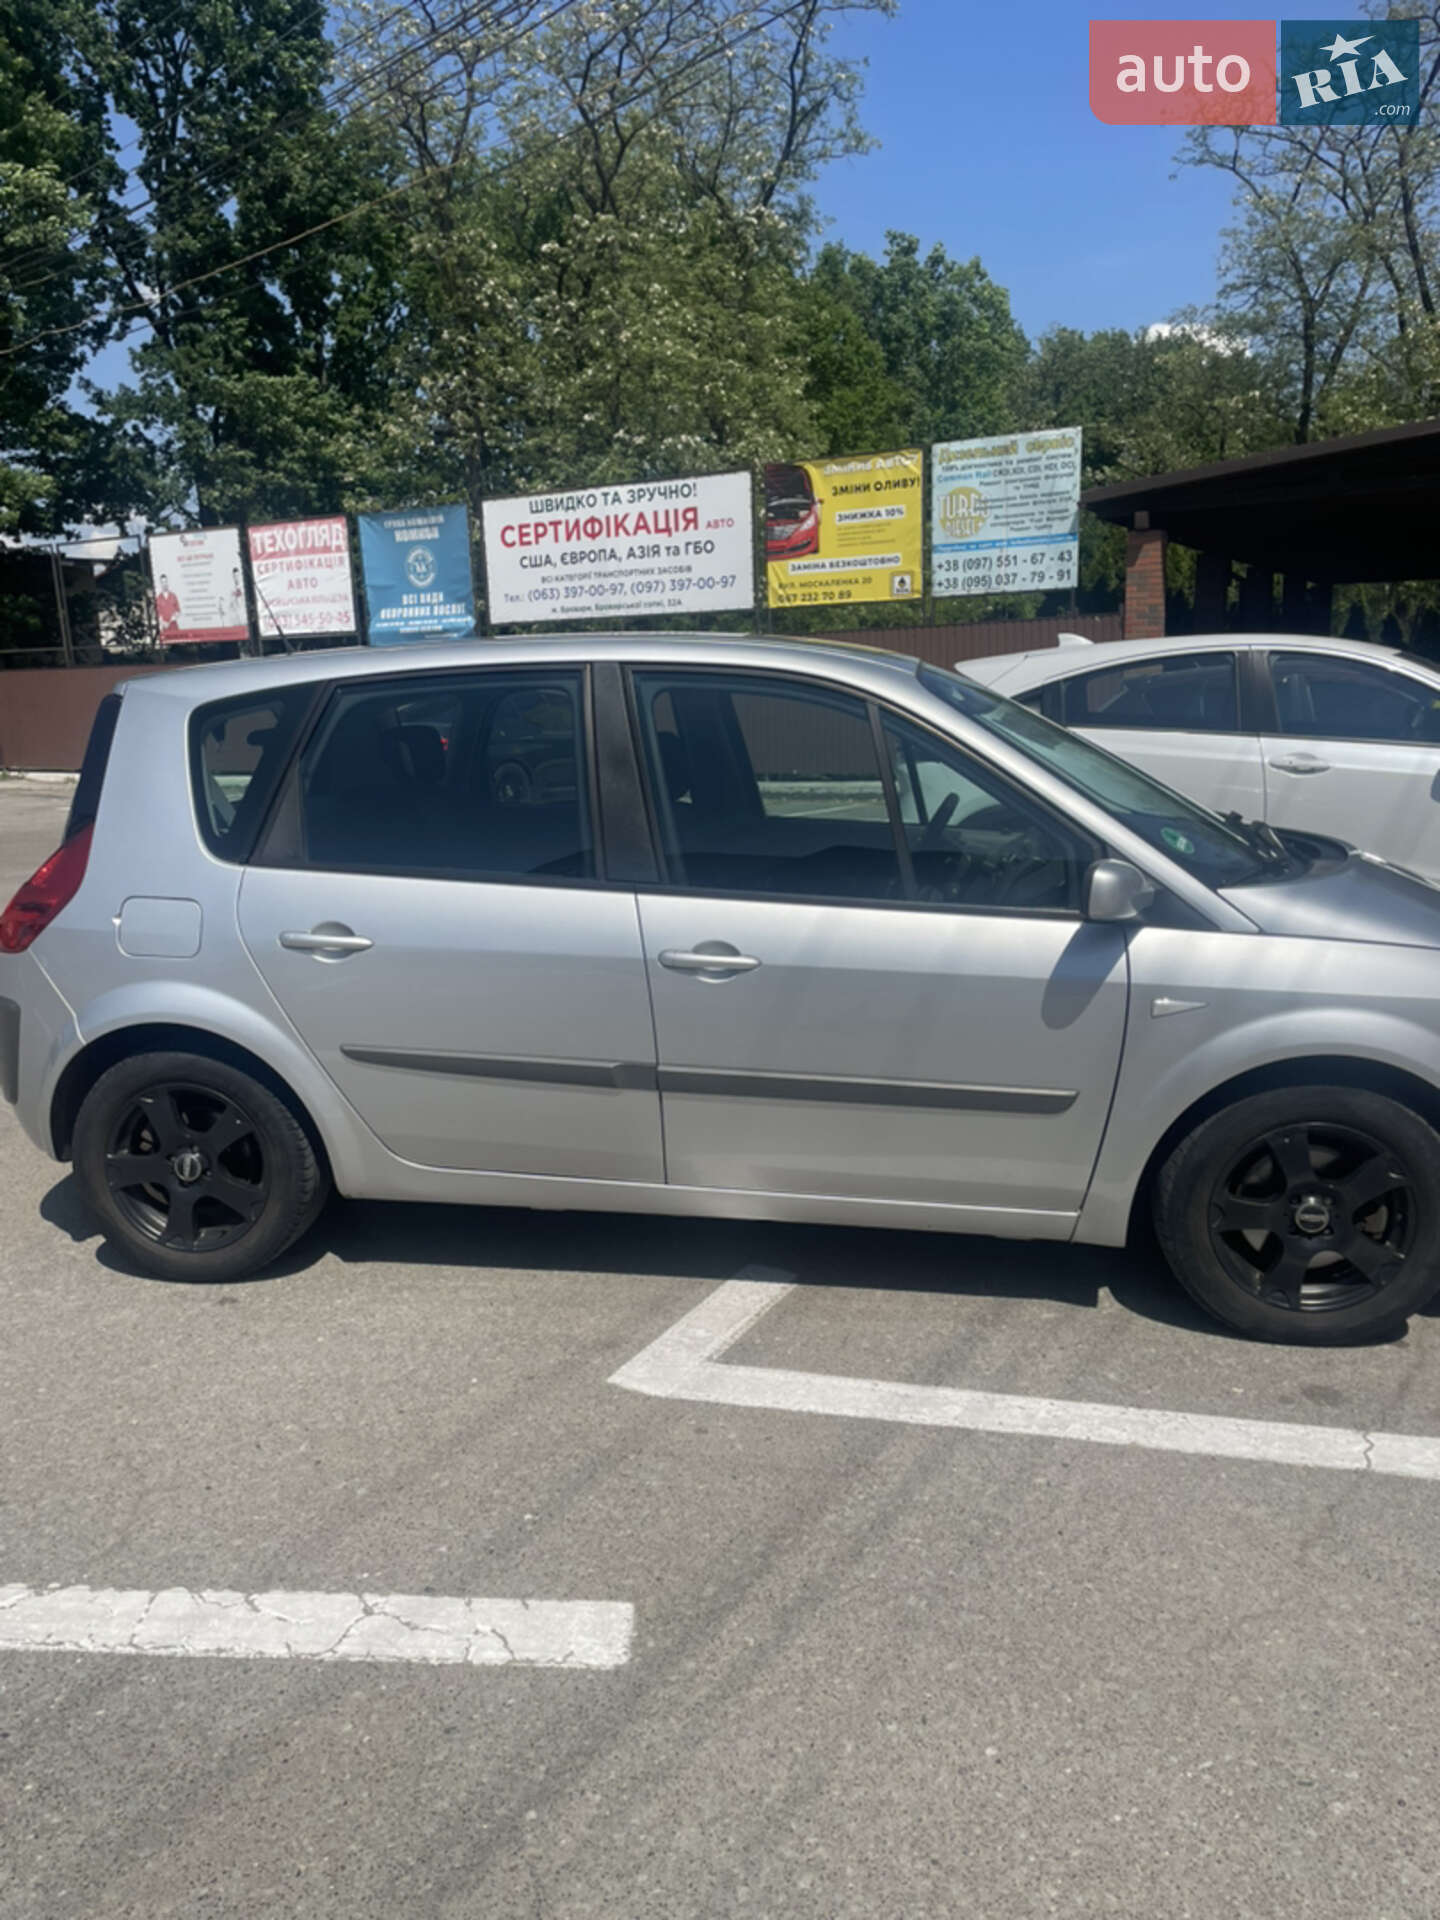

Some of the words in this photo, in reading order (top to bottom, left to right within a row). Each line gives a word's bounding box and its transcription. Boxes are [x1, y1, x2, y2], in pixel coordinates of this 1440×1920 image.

[832, 483, 871, 496] ЗМІНИ
[873, 476, 920, 492] ОЛИВУ!
[528, 493, 598, 514] ШВИДКО
[601, 491, 623, 506] ТА
[626, 482, 698, 504] ЗРУЧНО!
[500, 506, 699, 548] СЕРТИФІКАЦІЯ
[705, 517, 735, 529] АВТО
[838, 509, 882, 522] ЗНИЖКА
[252, 523, 346, 555] ТЕХОГЛЯД
[519, 553, 558, 569] США,
[560, 547, 623, 566] ЄВРОПА,
[626, 543, 662, 560] АЗІЯ
[665, 544, 681, 557] та
[684, 539, 716, 557] ГБО
[790, 561, 827, 572] ЗАМІНА
[829, 554, 901, 569] БЕЗКОШТОВНО
[937, 559, 960, 572] +38
[963, 556, 993, 573] (097)
[996, 554, 1018, 568] 551
[1030, 552, 1046, 565] 67
[1058, 549, 1073, 563] 43
[256, 556, 346, 576] СЕРТИФІКАЦІЯ
[287, 577, 319, 591] АВТО
[527, 587, 561, 603] (063)
[563, 581, 629, 599] 397-00-97,
[630, 579, 667, 597] (097)
[669, 573, 737, 593] 397-00-97
[962, 574, 993, 591] (095)
[995, 572, 1018, 586] 037
[1030, 570, 1046, 583] 79
[1056, 569, 1072, 582] 91
